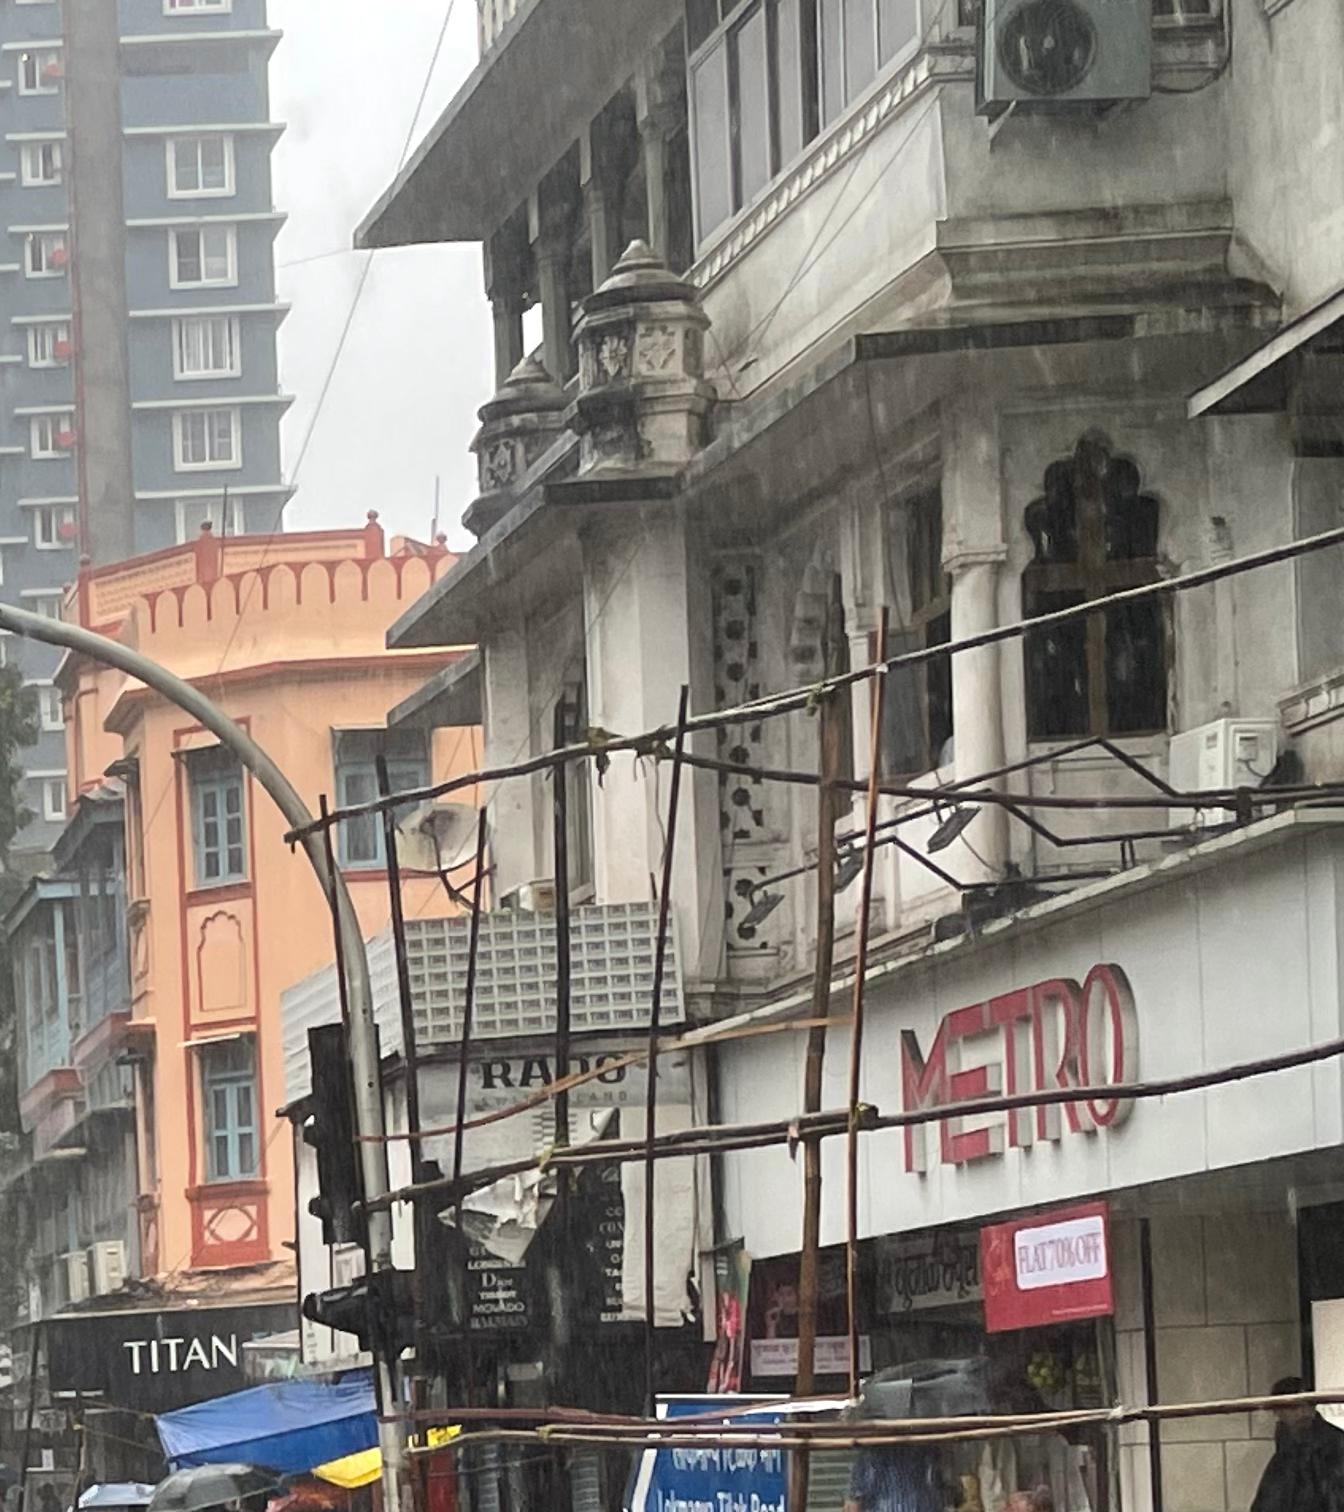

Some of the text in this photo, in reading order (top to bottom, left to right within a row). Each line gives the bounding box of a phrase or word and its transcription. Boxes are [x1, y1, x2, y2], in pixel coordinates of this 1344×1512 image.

[900, 962, 1141, 1175] METRO
[1018, 1242, 1047, 1274] FLAT
[1075, 1232, 1102, 1265] OFF
[123, 1333, 238, 1375] TITAN
